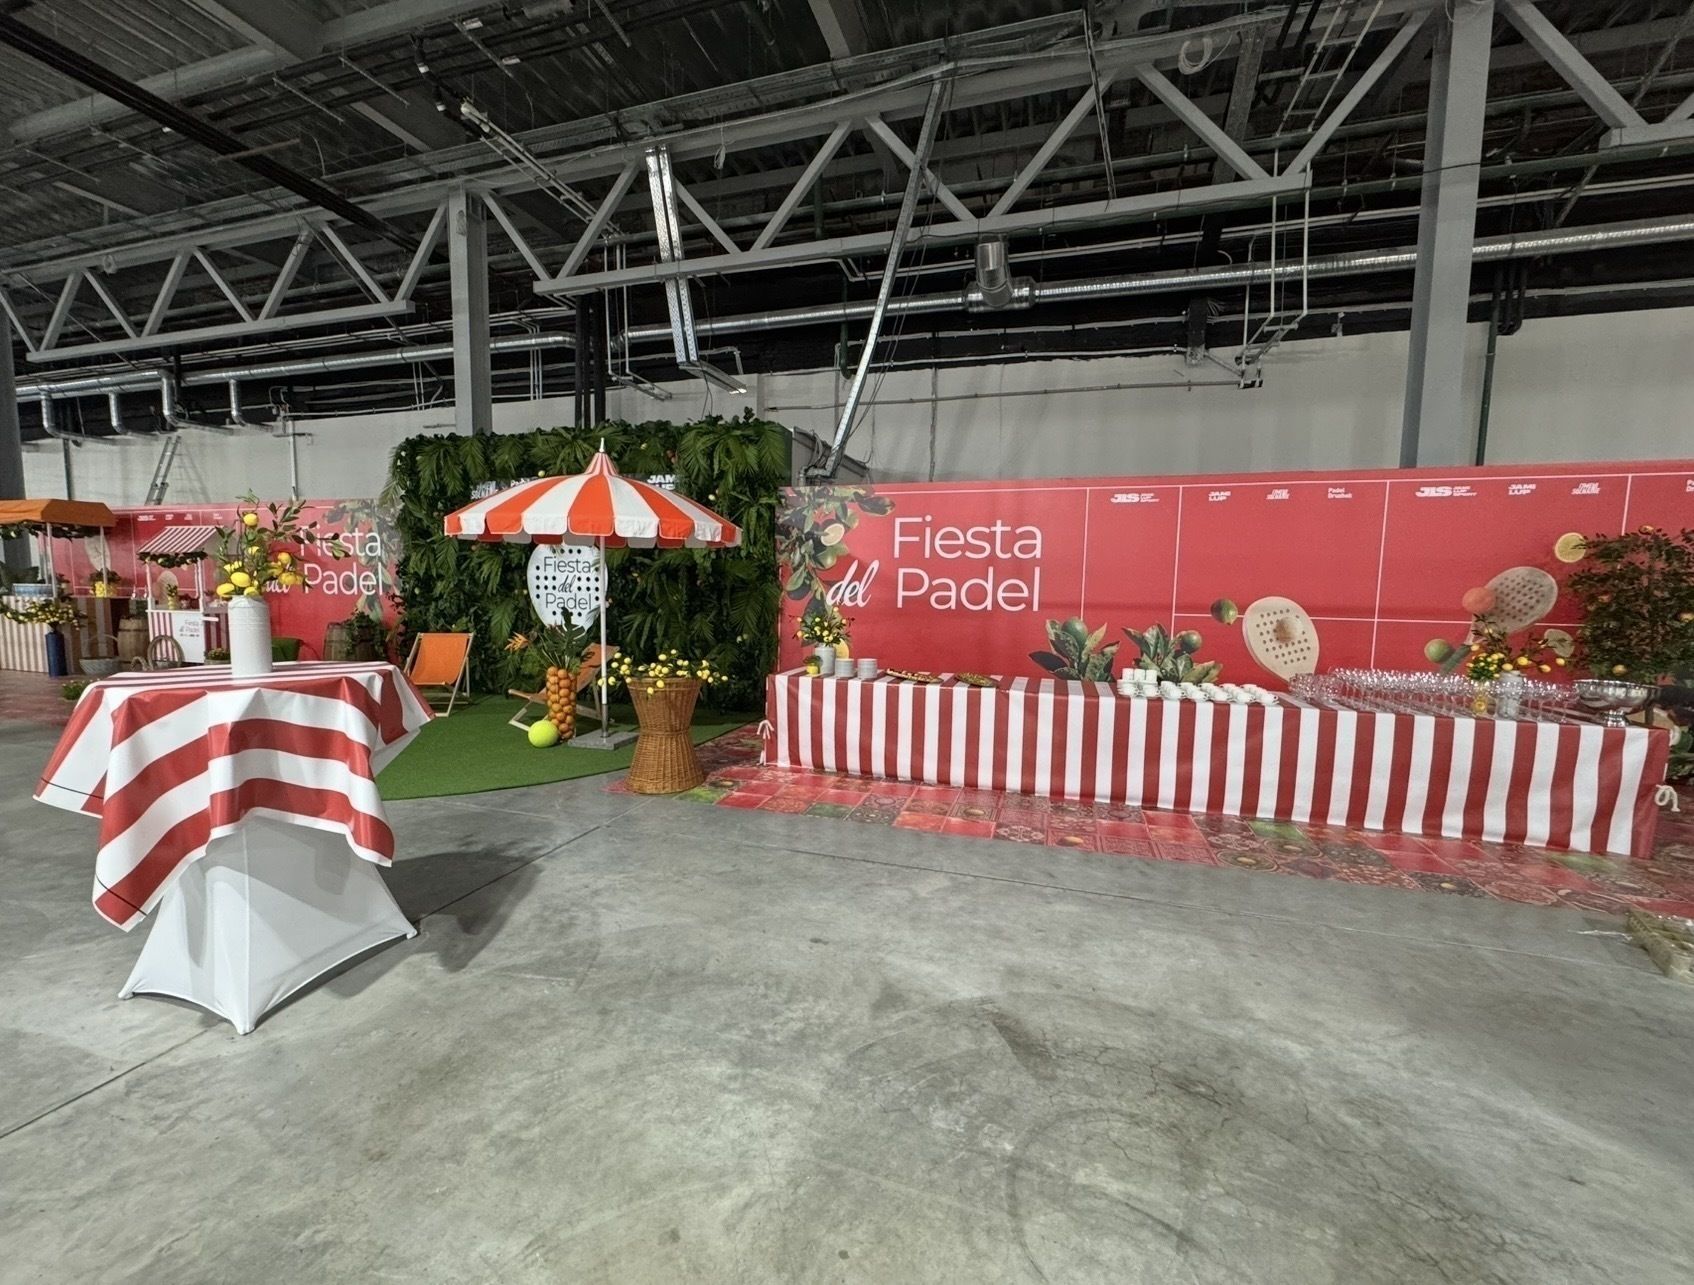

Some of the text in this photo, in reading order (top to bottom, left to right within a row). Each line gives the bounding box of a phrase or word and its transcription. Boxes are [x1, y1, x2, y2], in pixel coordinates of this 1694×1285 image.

[894, 515, 1042, 559] Fiesta
[543, 556, 591, 574] Fiesta
[303, 562, 383, 595] Padel
[557, 574, 577, 593] del
[826, 559, 1041, 612] del Padel
[545, 592, 592, 611] Padel
